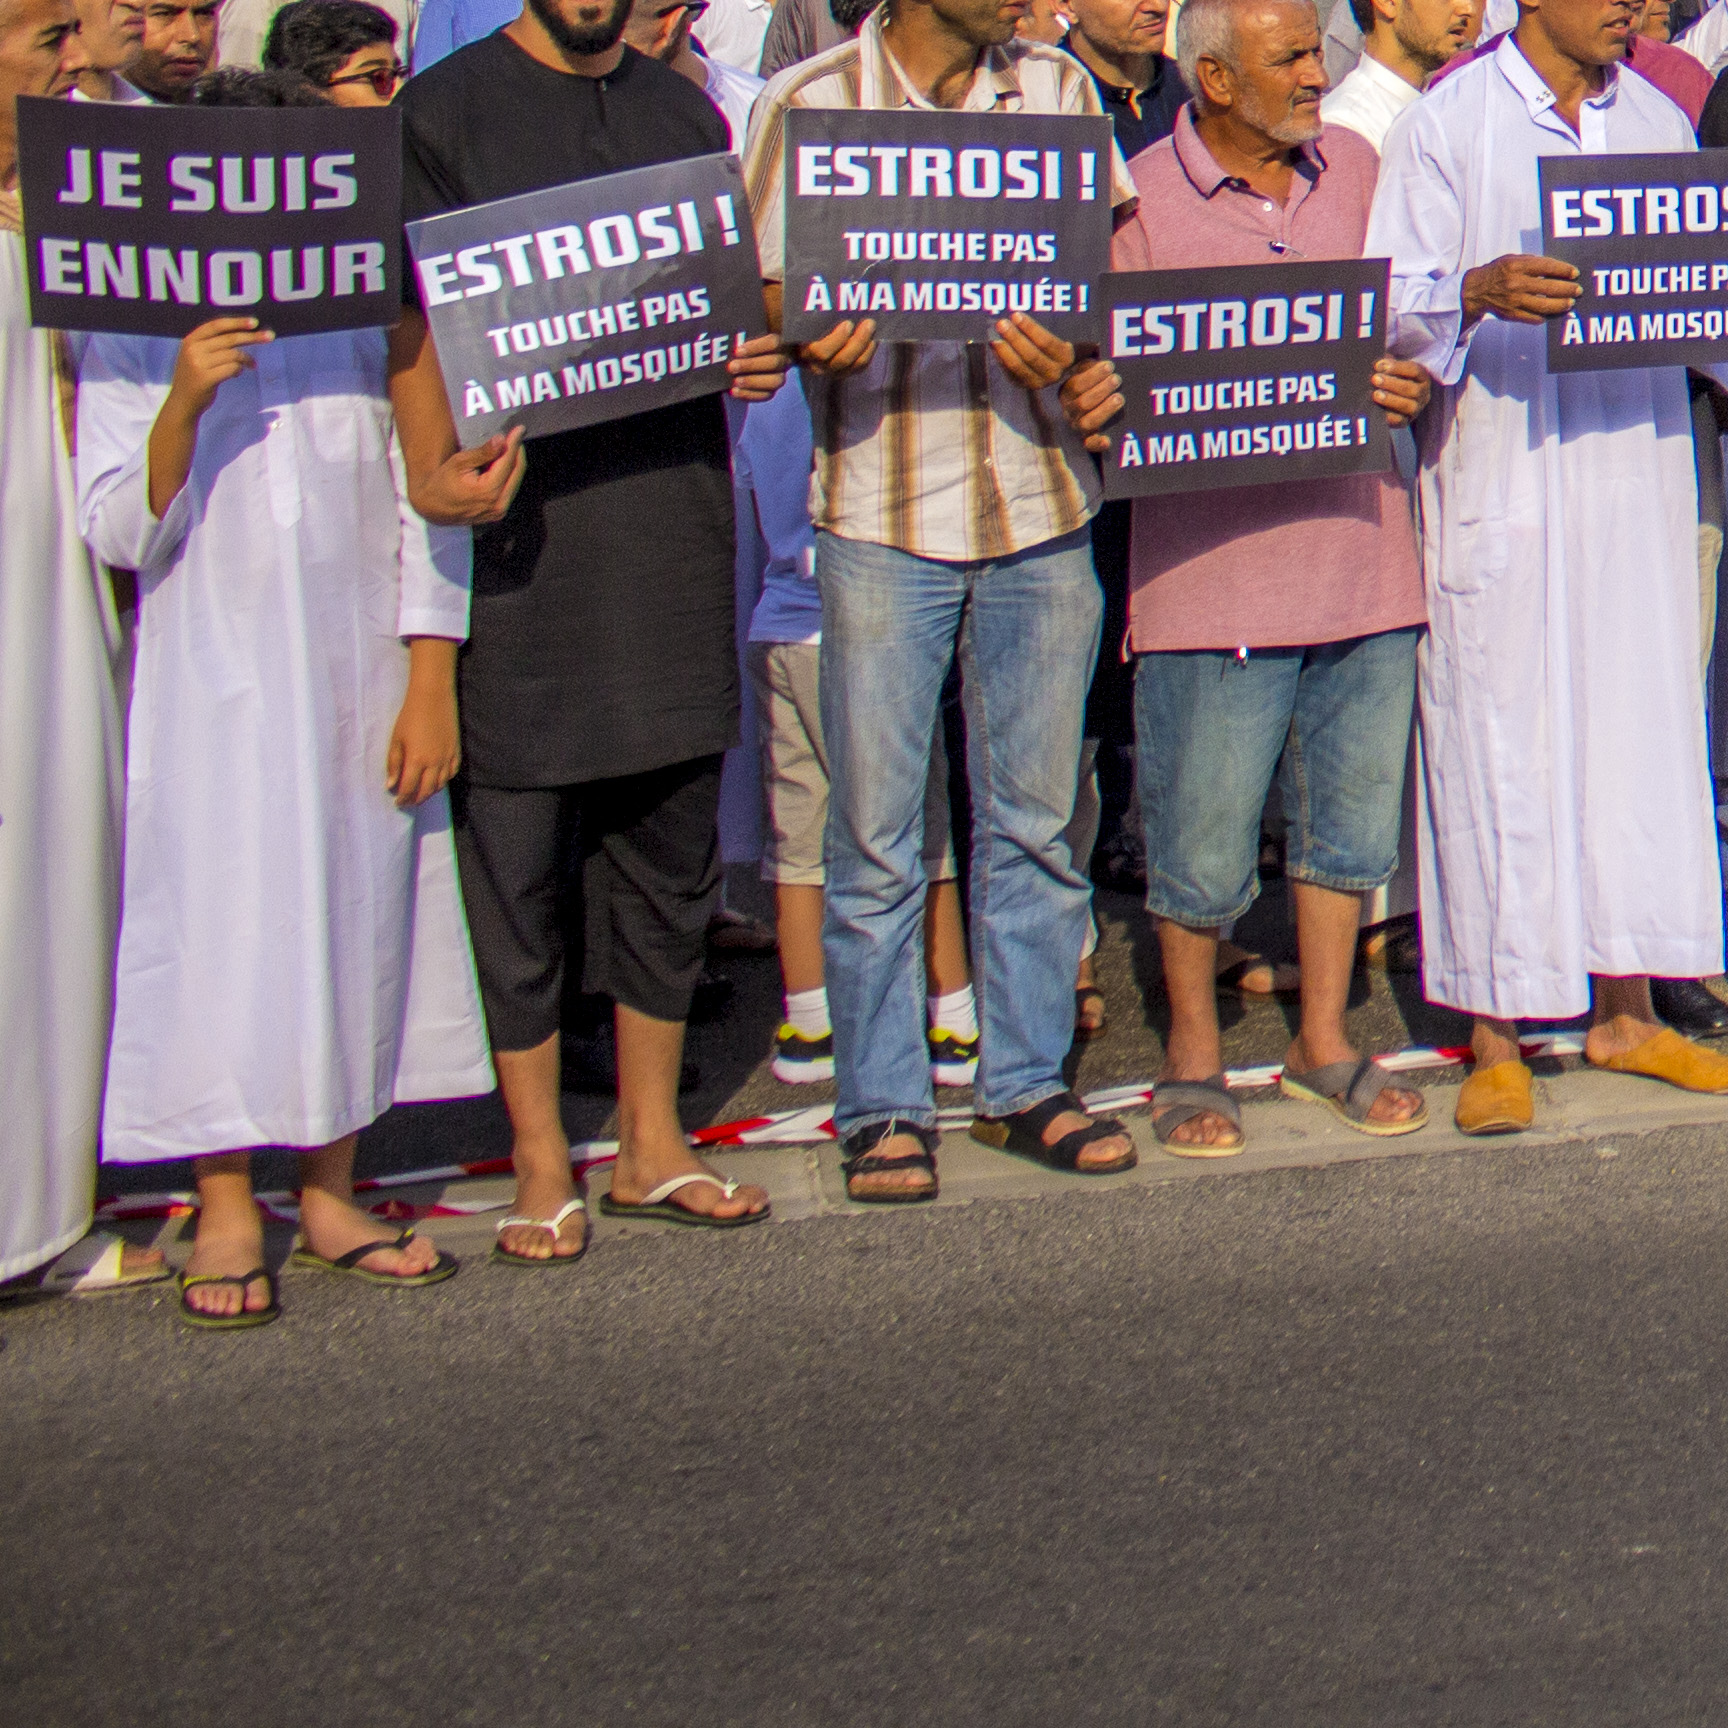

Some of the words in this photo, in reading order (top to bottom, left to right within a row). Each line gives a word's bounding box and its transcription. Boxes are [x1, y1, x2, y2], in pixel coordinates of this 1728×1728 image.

[59, 148, 143, 209] JE
[170, 153, 358, 213] SUIS
[798, 145, 1060, 200] ESTROSI
[41, 237, 386, 307] ENNOUR
[418, 201, 704, 307] ESTROSI
[843, 231, 986, 261] TOUCHE
[992, 233, 1056, 263] PAS
[805, 275, 832, 311] À
[838, 280, 897, 311] MA
[903, 277, 1071, 314] MOSQUÉE
[1592, 265, 1707, 297] TOUCHE
[486, 301, 640, 358] TOUCHE
[643, 287, 711, 328] PAS
[1112, 294, 1343, 358] ESTROSI
[1562, 311, 1584, 346] À
[1589, 315, 1635, 344] MA
[465, 379, 494, 418] À
[497, 371, 560, 410] MA
[561, 332, 732, 397] MOSQUÉE
[1150, 378, 1274, 416] TOUCHE
[1278, 373, 1335, 405] PAS
[1120, 432, 1143, 468] À
[1148, 433, 1198, 465] MA
[1202, 415, 1352, 459] MOSQUÉE
